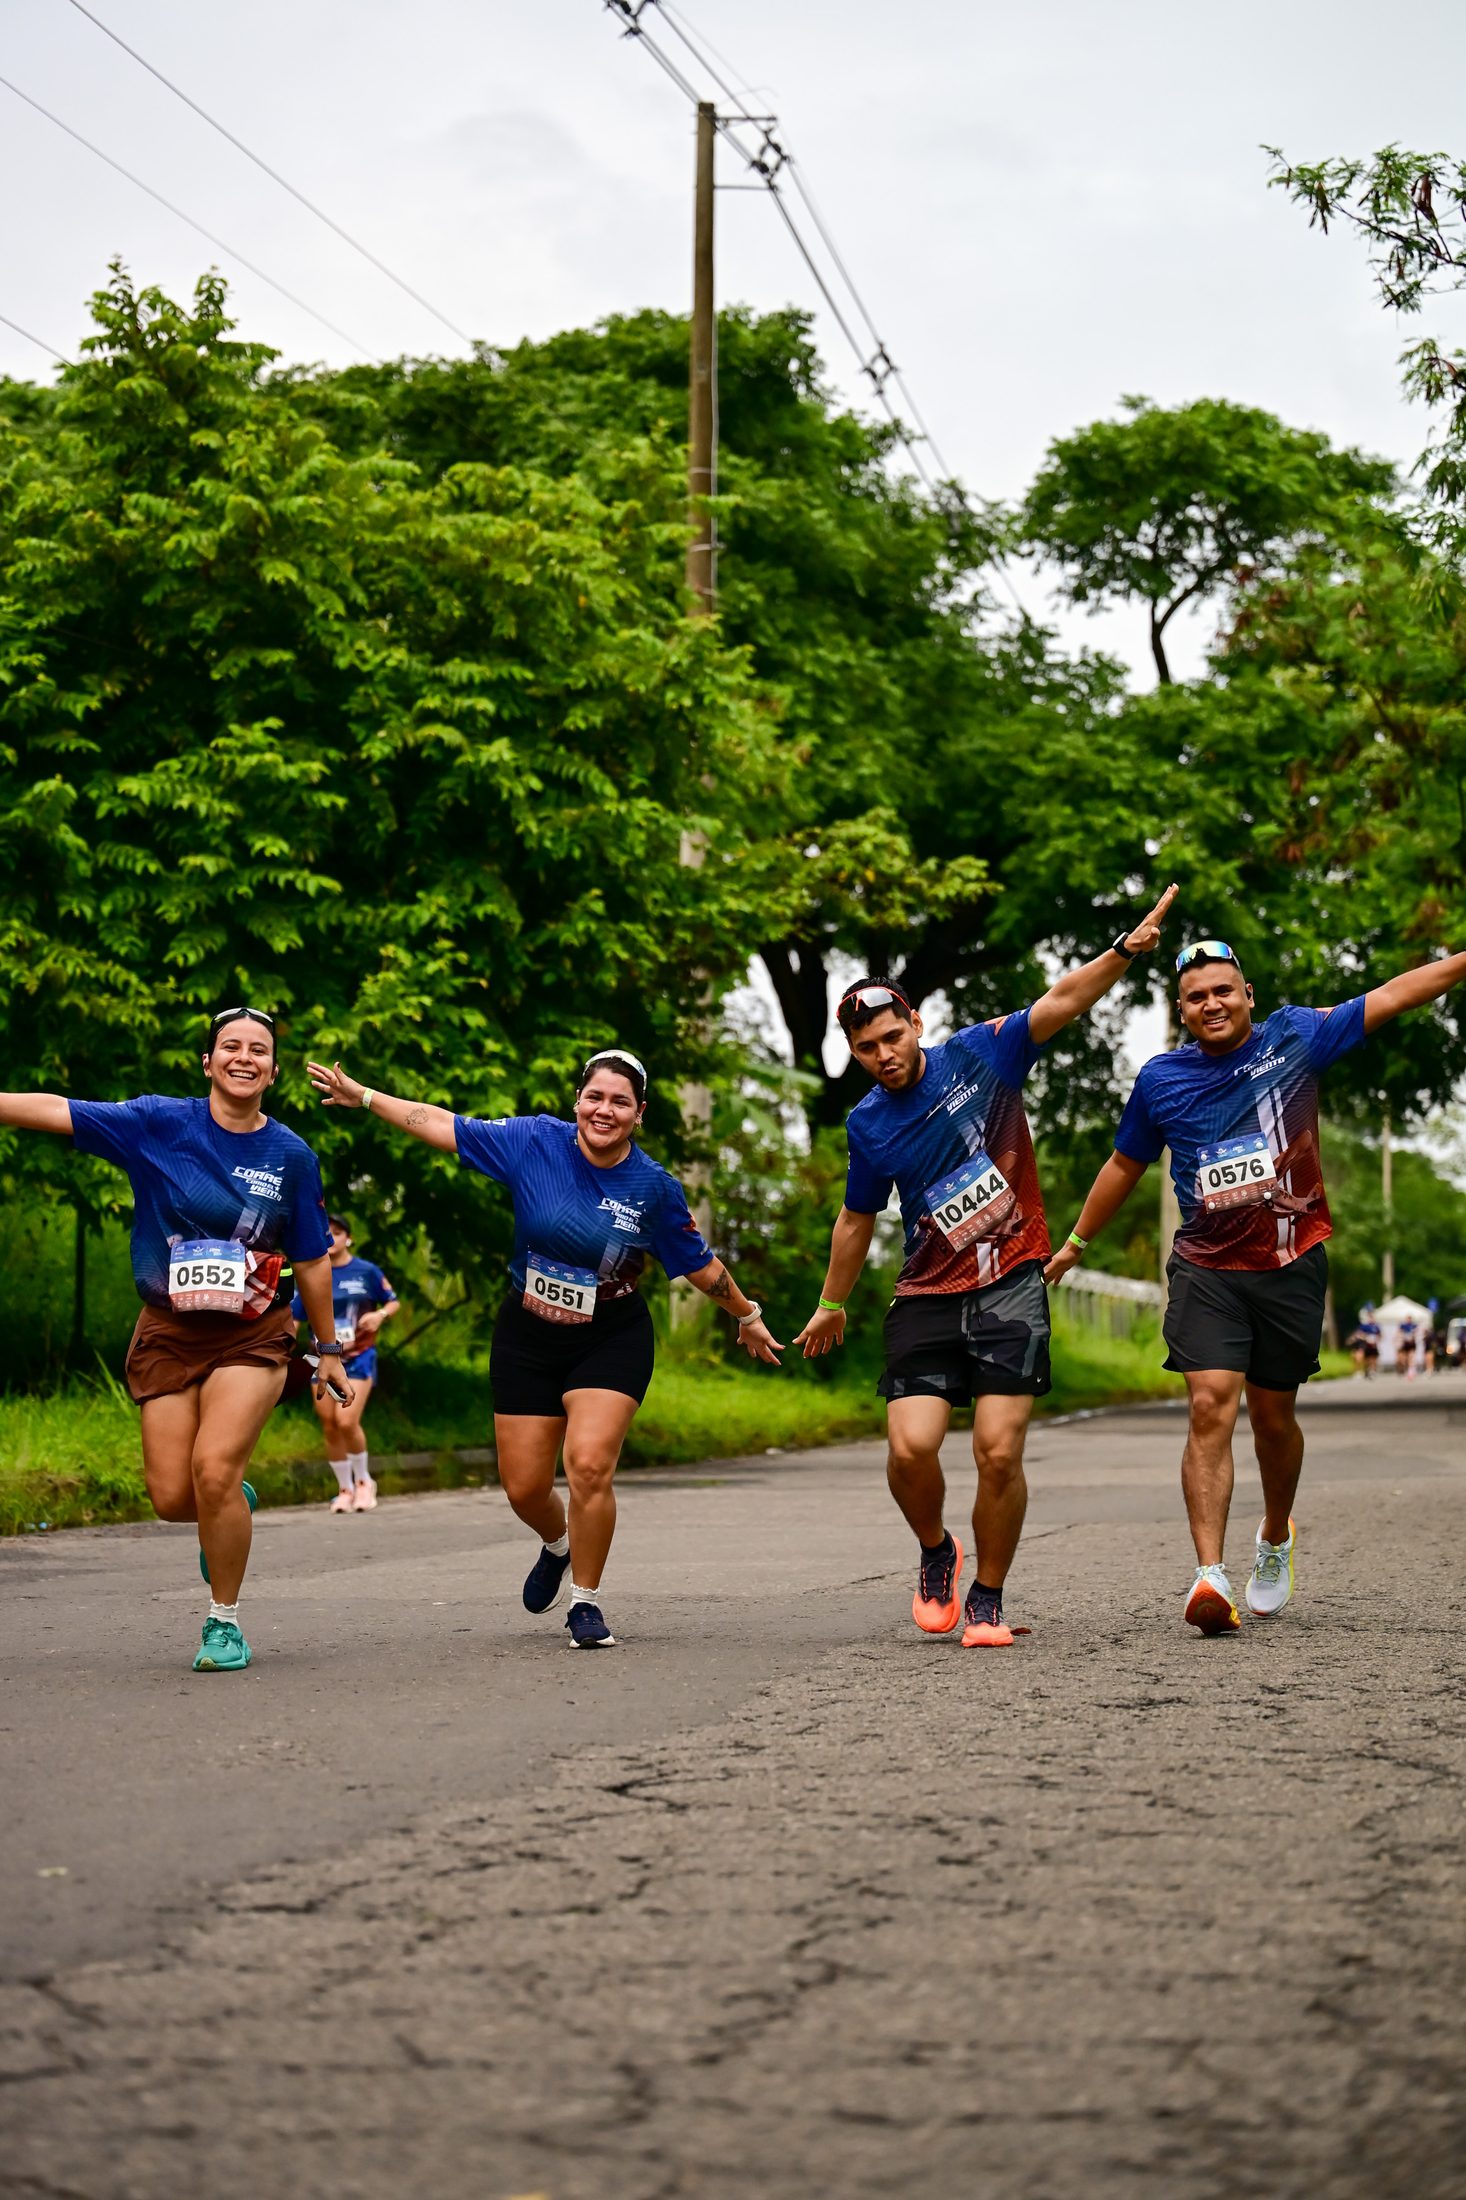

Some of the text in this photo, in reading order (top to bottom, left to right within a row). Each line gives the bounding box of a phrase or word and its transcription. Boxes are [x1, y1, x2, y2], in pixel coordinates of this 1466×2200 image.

[946, 1083, 979, 1112] VIENTO
[234, 1166, 283, 1186] CORRE
[1208, 1158, 1265, 1188] 0576
[250, 1184, 282, 1202] VIENTO
[935, 1173, 1004, 1229] 10444
[177, 1265, 236, 1287] 0552
[534, 1277, 584, 1309] 0551
